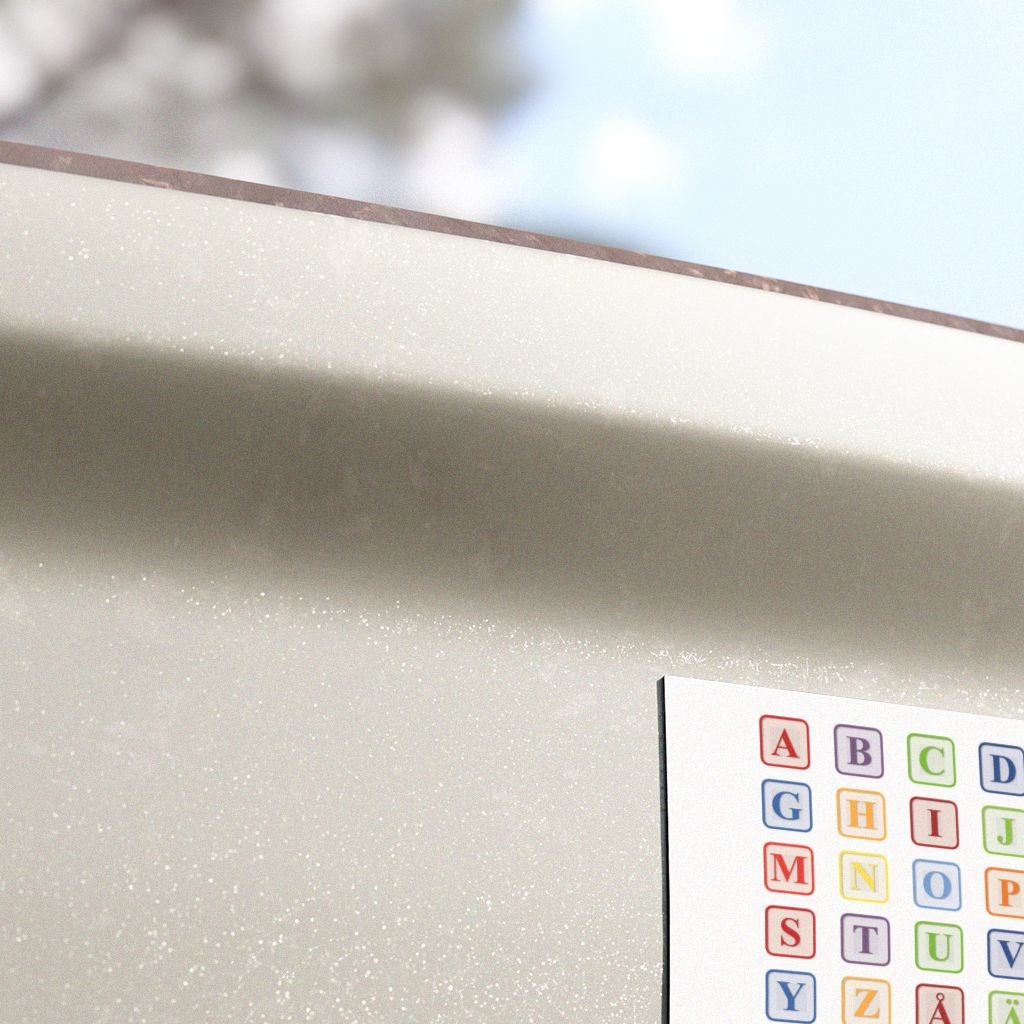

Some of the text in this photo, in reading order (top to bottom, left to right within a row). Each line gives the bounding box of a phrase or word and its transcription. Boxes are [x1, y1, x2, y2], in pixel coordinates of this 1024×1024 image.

[772, 729, 799, 758] A
[848, 736, 872, 766] B
[919, 746, 944, 775] C
[991, 754, 1016, 784] D
[772, 791, 801, 821] G
[849, 799, 874, 829] H
[929, 809, 940, 837] I
[997, 818, 1013, 845] J
[773, 853, 806, 884] M
[852, 862, 875, 891] N
[923, 871, 952, 900] O
[1000, 879, 1020, 907] P
[780, 917, 801, 947] S
[853, 925, 878, 954] T
[928, 932, 951, 961] U
[998, 940, 1024, 968] V
[778, 981, 805, 1011] Y
[854, 988, 880, 1019] Z
